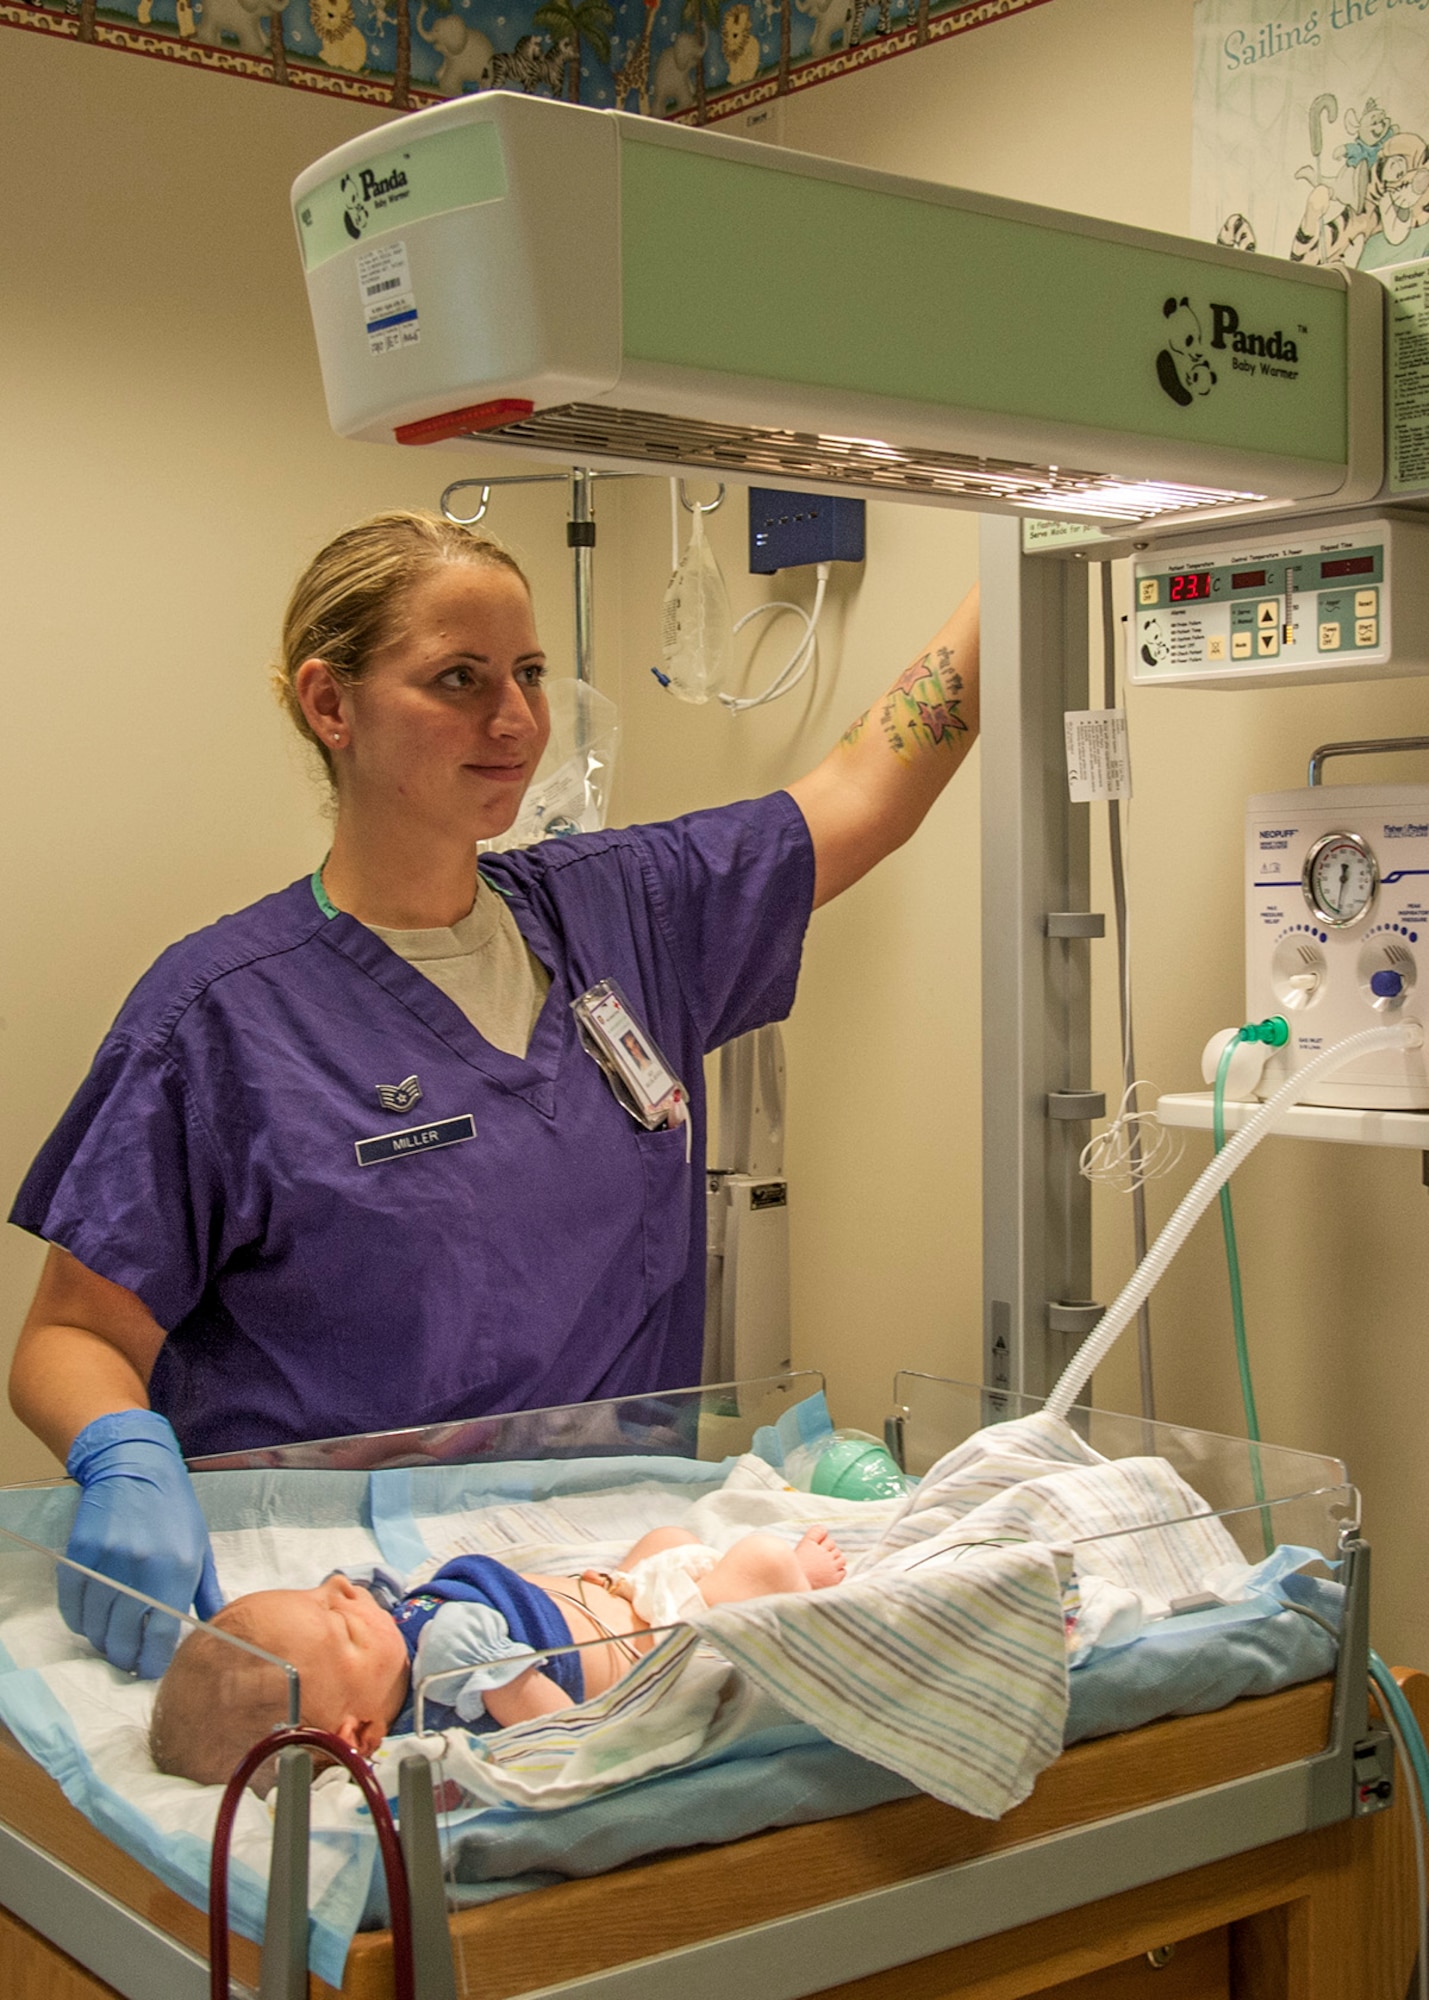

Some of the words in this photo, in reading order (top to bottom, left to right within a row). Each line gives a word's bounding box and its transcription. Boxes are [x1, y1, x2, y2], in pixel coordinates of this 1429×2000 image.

[1223, 10, 1321, 70] Sailing
[1329, 0, 1378, 30] the
[358, 168, 408, 202] Panda
[1209, 303, 1299, 363] Panda
[1232, 356, 1256, 377] Baby
[1259, 362, 1299, 380] Warmer
[1186, 561, 1215, 569] Temperature
[1249, 552, 1279, 560] Temperature
[1171, 574, 1211, 600] 23.1
[392, 1130, 440, 1151] MILLER
